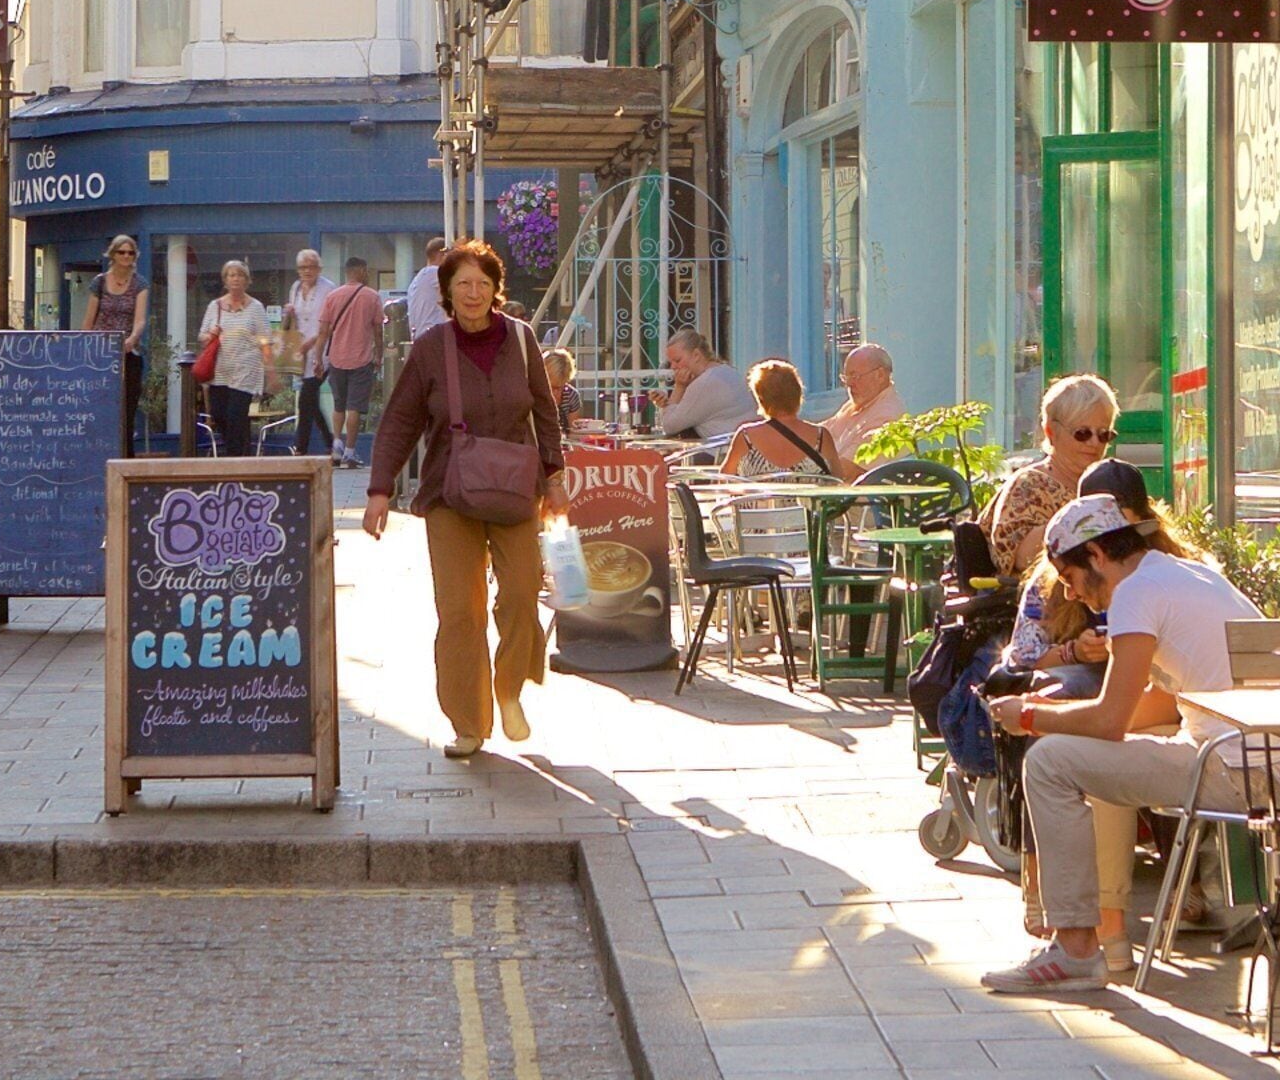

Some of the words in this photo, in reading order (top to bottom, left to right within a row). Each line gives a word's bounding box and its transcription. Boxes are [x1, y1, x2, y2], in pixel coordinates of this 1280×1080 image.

[26, 145, 56, 170] café
[0, 333, 60, 366] MOCK
[13, 374, 38, 395] day
[31, 394, 53, 407] and
[0, 425, 33, 437] Welsh
[42, 423, 88, 436] rarebit
[563, 465, 660, 503] DRURY
[572, 494, 594, 508] TEAS
[607, 490, 648, 508] COFFEES
[155, 482, 270, 555] Boho
[618, 515, 654, 530] Here
[206, 521, 282, 567] gelato
[137, 564, 229, 592] Italian
[230, 563, 303, 601] Style
[180, 593, 254, 628] ICE
[131, 625, 302, 669] CREAM
[138, 679, 227, 709] Amazing
[231, 674, 308, 700] milkshakes
[141, 705, 191, 737] floats
[200, 705, 234, 725] and
